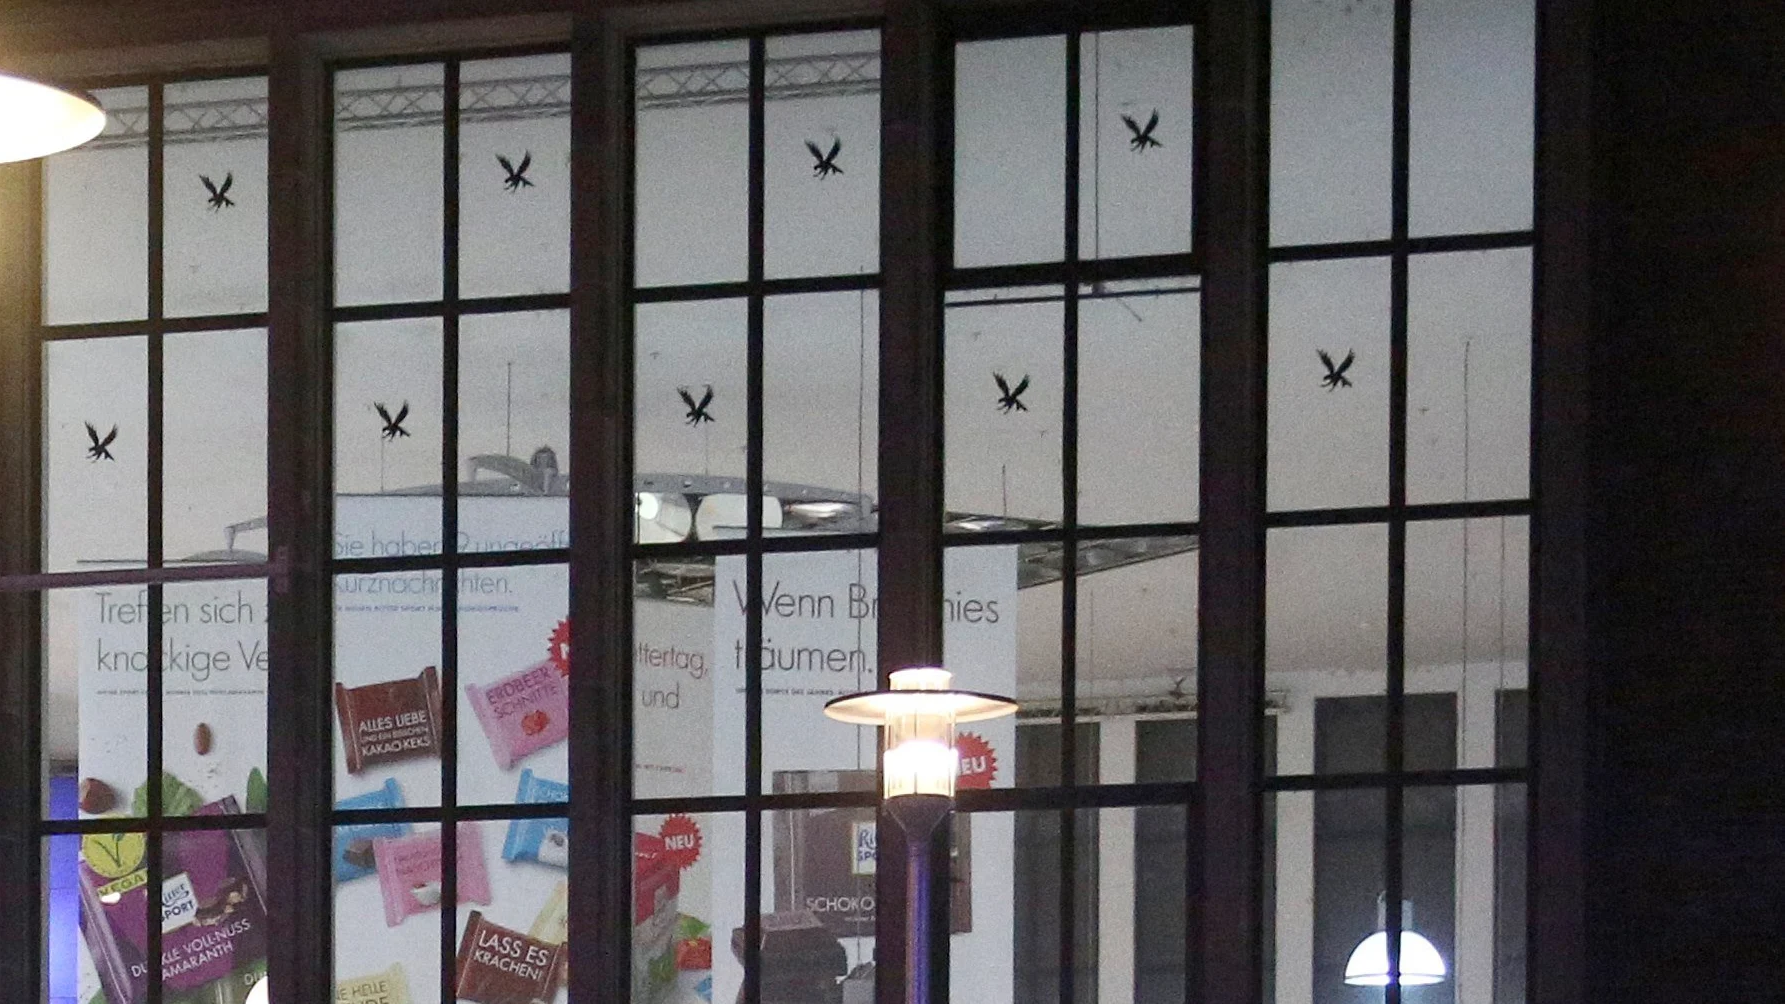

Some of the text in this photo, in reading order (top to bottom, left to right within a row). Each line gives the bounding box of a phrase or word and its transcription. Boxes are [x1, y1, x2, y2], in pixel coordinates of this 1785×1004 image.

[96, 589, 253, 624] Trefen sich
[98, 637, 230, 681] knakige
[734, 637, 873, 673] täumen.
[642, 682, 680, 710] und
[359, 709, 427, 733] ALLES LIEBE
[664, 833, 695, 851] NEU
[479, 930, 550, 967] LASS ES
[472, 950, 544, 981] KRACHEN!
